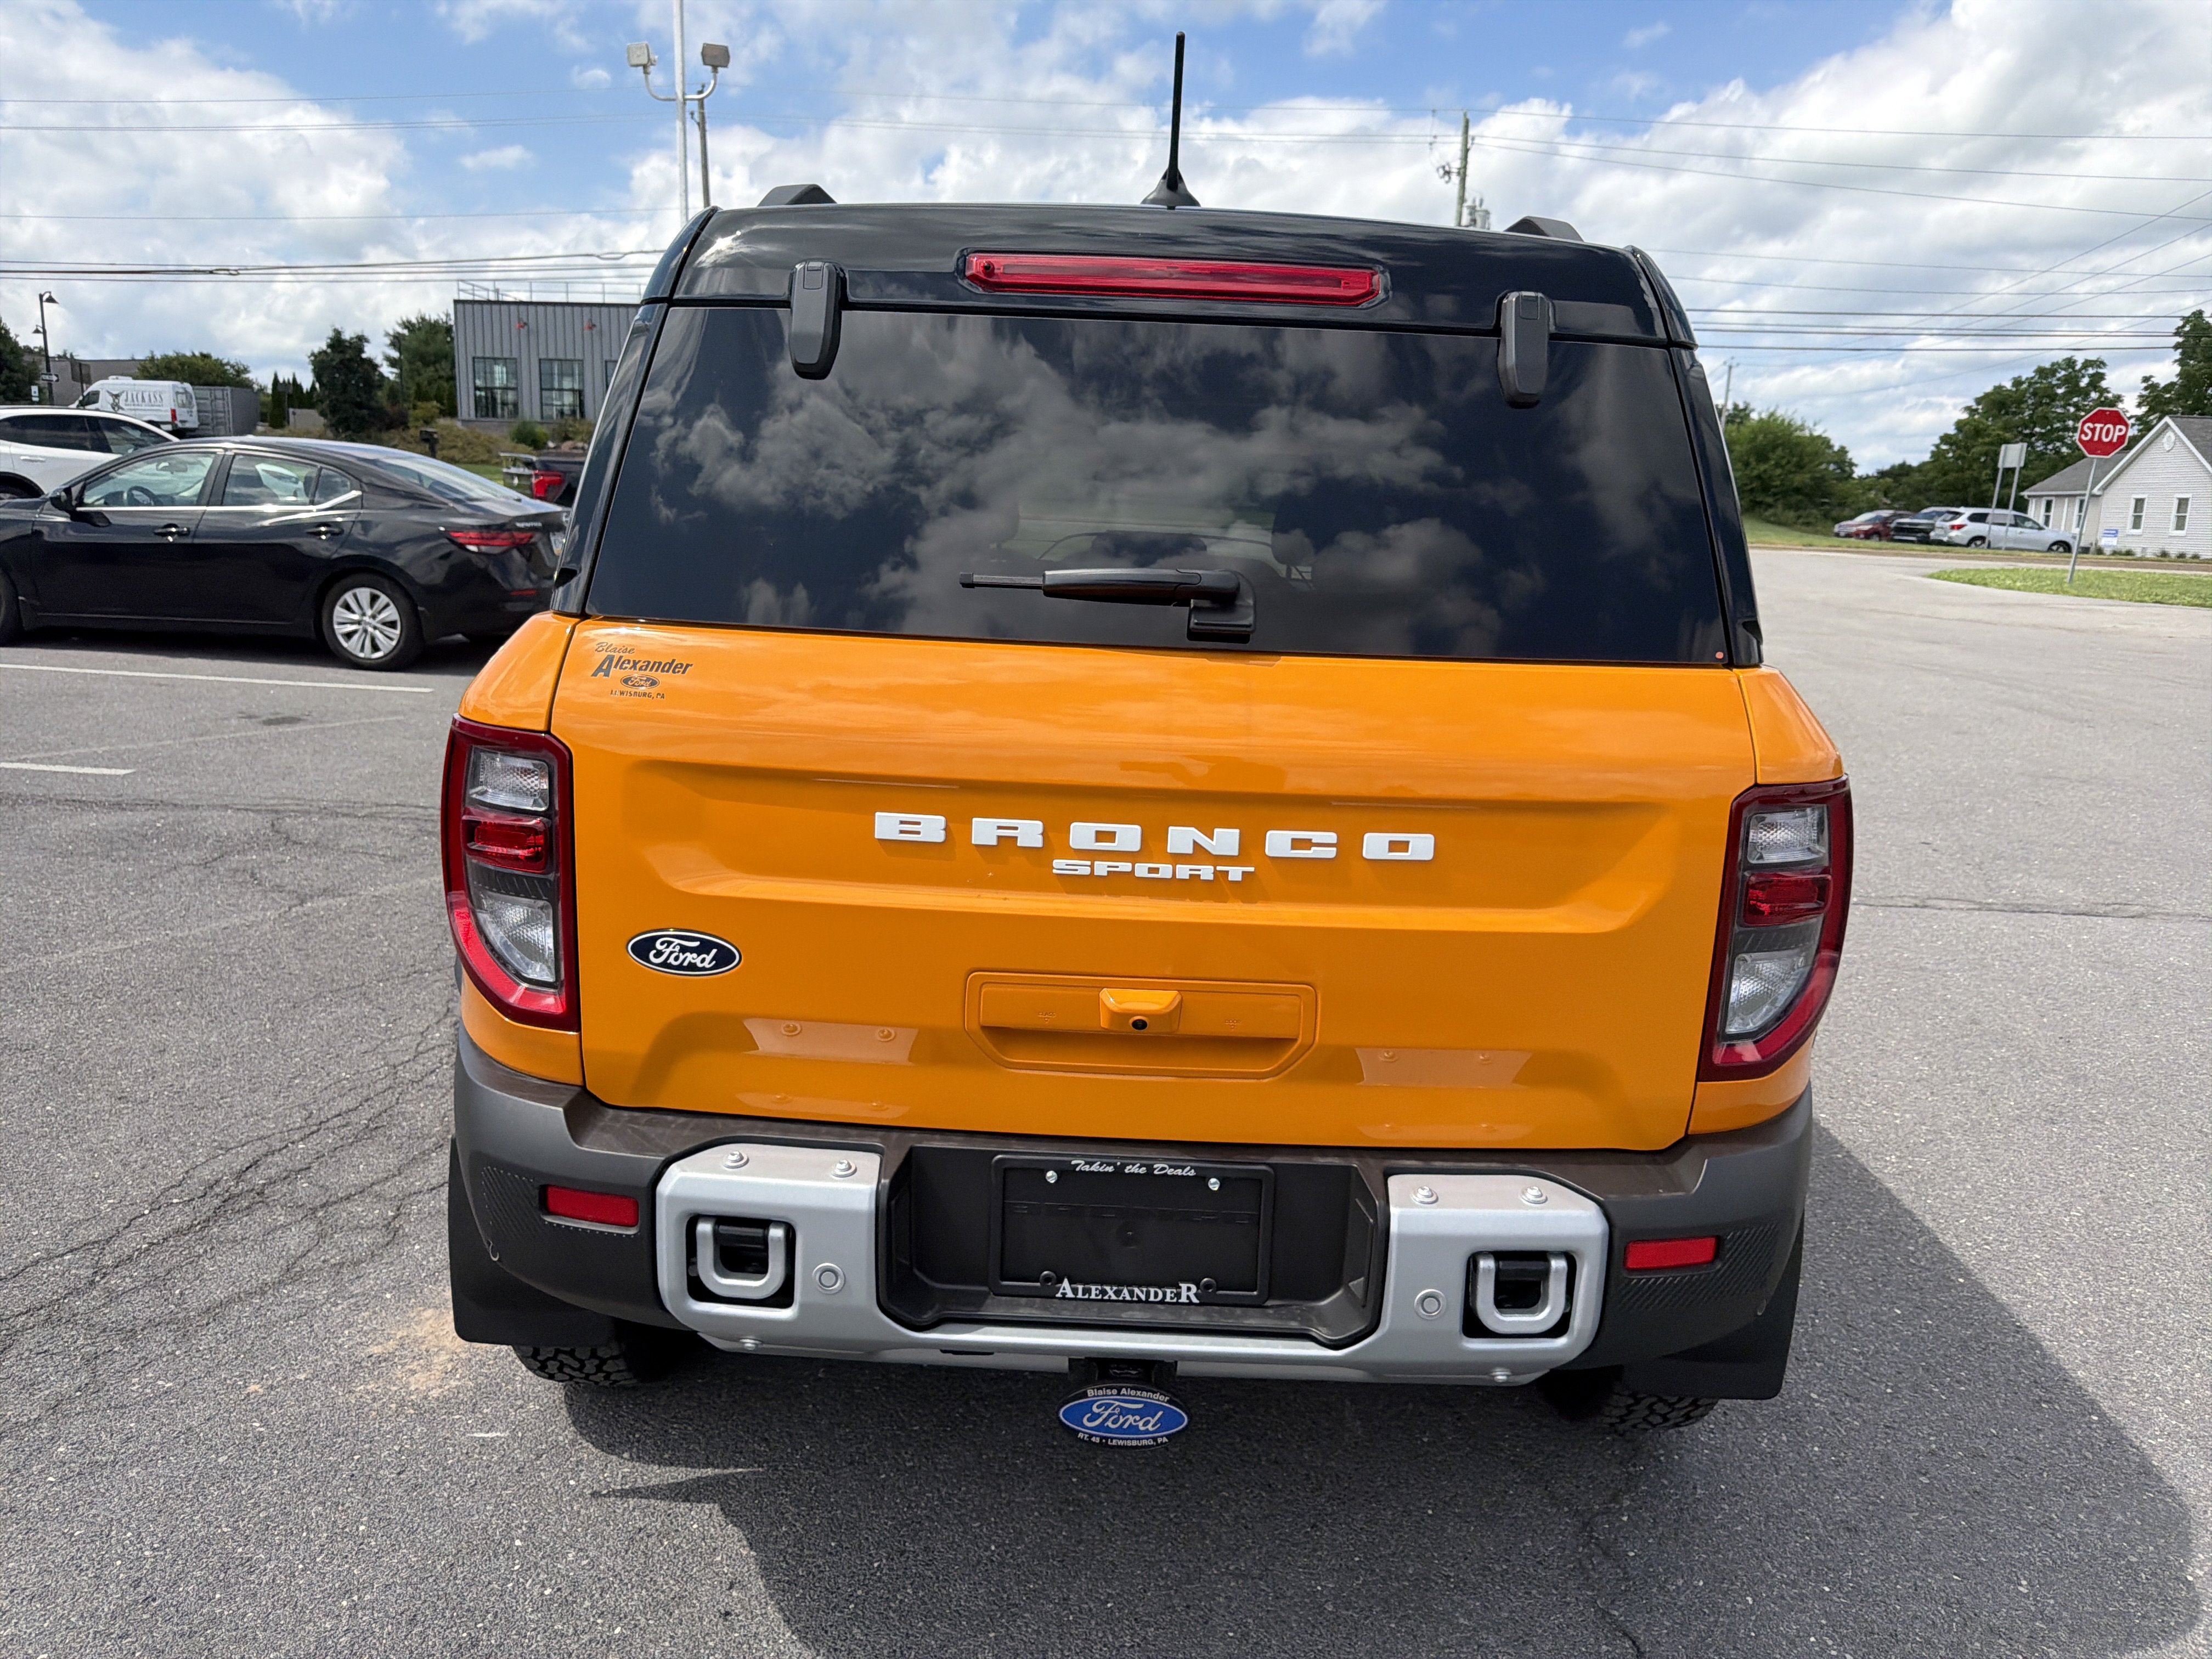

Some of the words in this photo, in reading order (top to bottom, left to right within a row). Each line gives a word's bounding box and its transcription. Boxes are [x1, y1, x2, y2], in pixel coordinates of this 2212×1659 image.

[2081, 422, 2126, 442] STOP
[595, 642, 635, 654] Blaise
[591, 654, 693, 678] Alexander
[628, 676, 651, 687] Ford
[874, 811, 1435, 861] BRONCO
[1052, 859, 1255, 881] SPORT
[649, 937, 718, 968] Ford
[1071, 1160, 1121, 1172] Takin'
[1125, 1163, 1147, 1174] the
[1153, 1164, 1197, 1176] Deals
[1056, 1277, 1200, 1304] ALEXANDER
[1087, 1388, 1118, 1397] Blaise
[1120, 1387, 1170, 1402] Alexander
[1082, 1400, 1164, 1431] Ford
[1108, 1438, 1156, 1447] LEWISBURG,
[1158, 1436, 1169, 1444] PA
